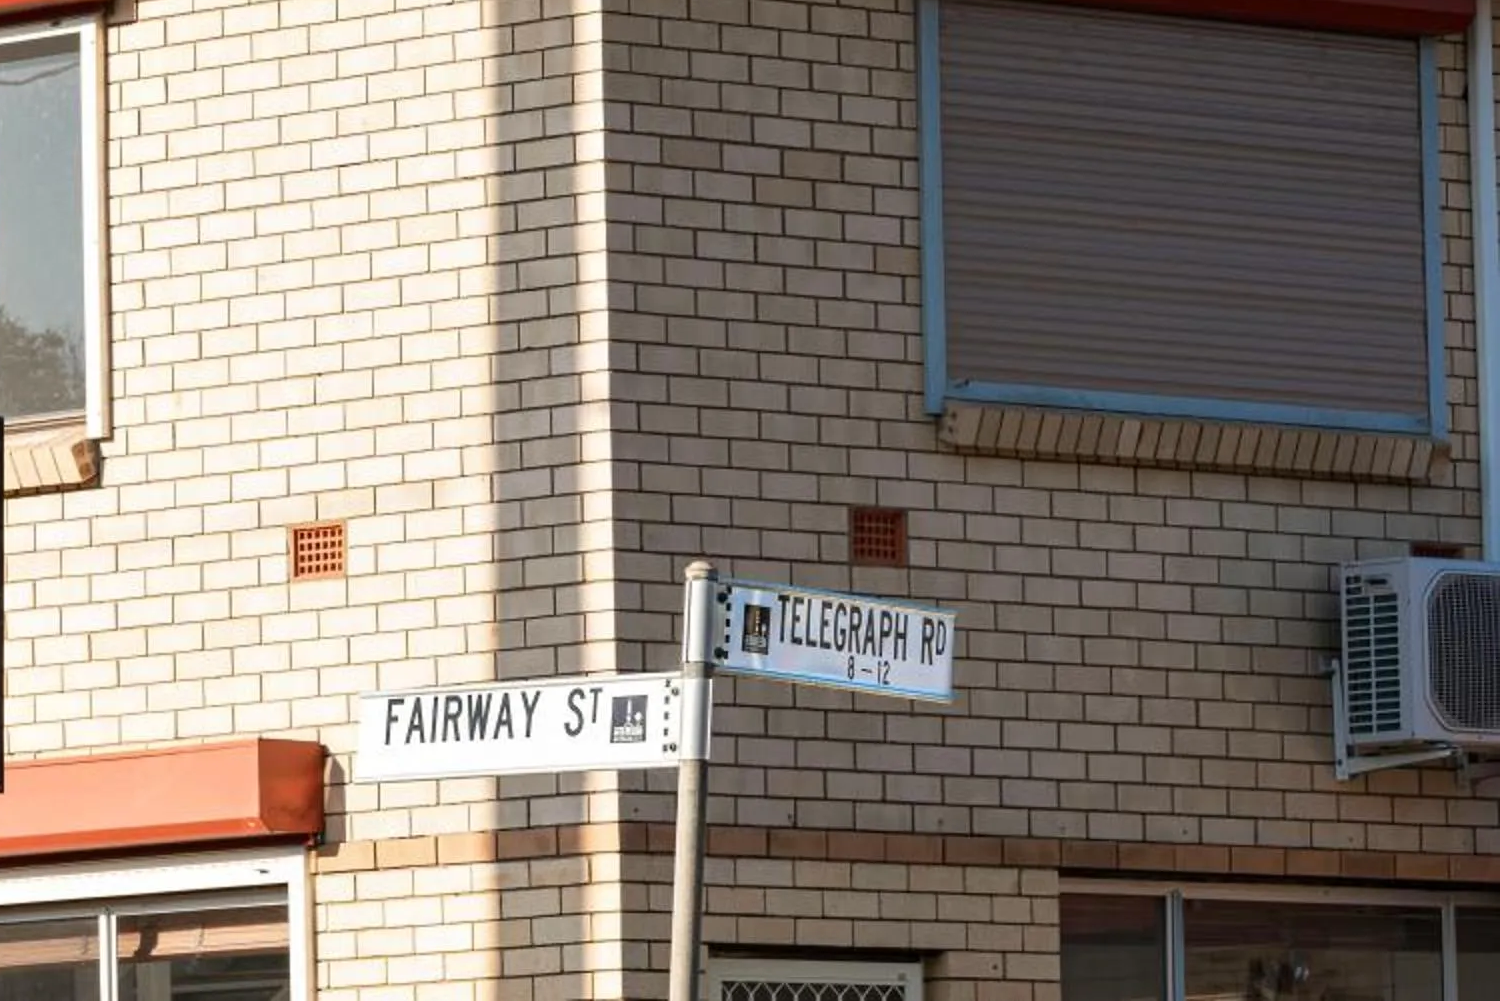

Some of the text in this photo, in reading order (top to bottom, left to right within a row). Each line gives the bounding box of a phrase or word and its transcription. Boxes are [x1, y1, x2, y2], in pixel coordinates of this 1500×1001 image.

[777, 594, 947, 666] TELEGRAPH RD
[385, 687, 603, 745] FAIRWAY ST
